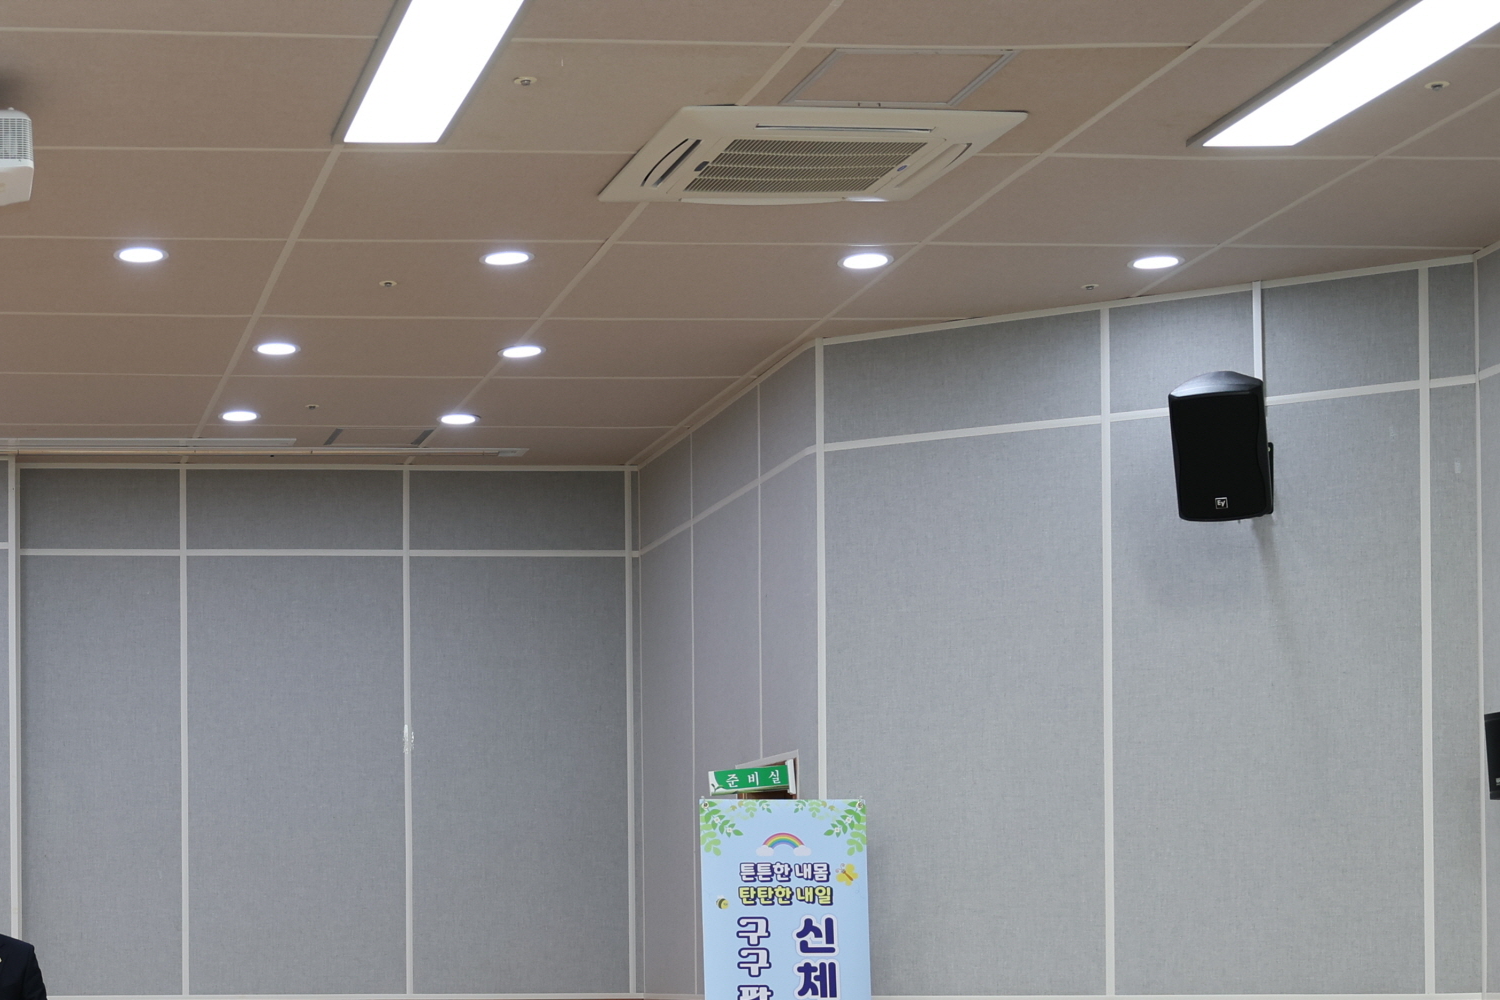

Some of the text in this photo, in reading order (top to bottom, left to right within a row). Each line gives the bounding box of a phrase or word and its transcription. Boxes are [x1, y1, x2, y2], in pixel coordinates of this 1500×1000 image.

[725, 769, 782, 788] 준비실
[739, 862, 831, 883] 튼튼한 내몸
[738, 886, 834, 906] 탄탄한 내일
